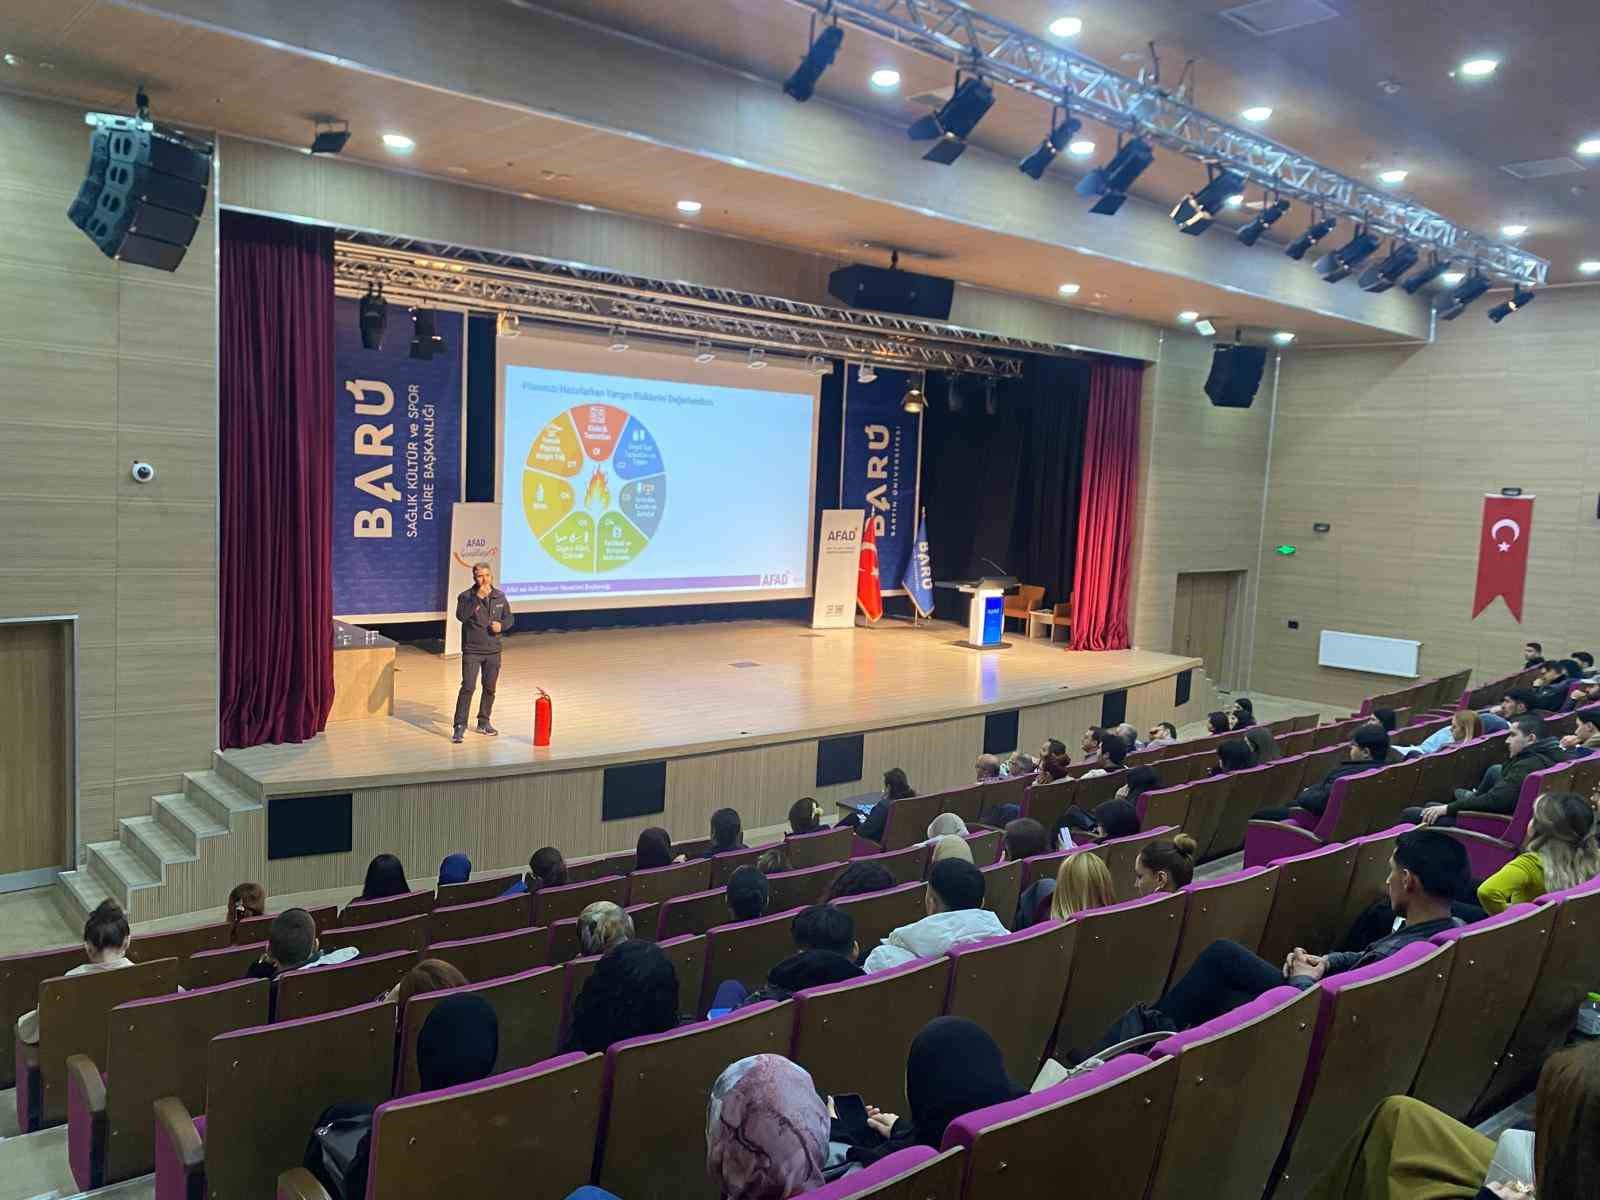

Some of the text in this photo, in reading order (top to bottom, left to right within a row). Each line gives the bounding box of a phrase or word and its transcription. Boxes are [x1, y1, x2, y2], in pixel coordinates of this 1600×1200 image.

[345, 379, 402, 539] BARÜ
[405, 384, 421, 538] SAĞLIK KÜLTÜR ve SPOR
[422, 404, 437, 521] DAİRE BAŞKANLIĞI
[466, 538, 486, 547] AFAD
[827, 530, 855, 542] AFAD
[762, 574, 787, 585] AFAD
